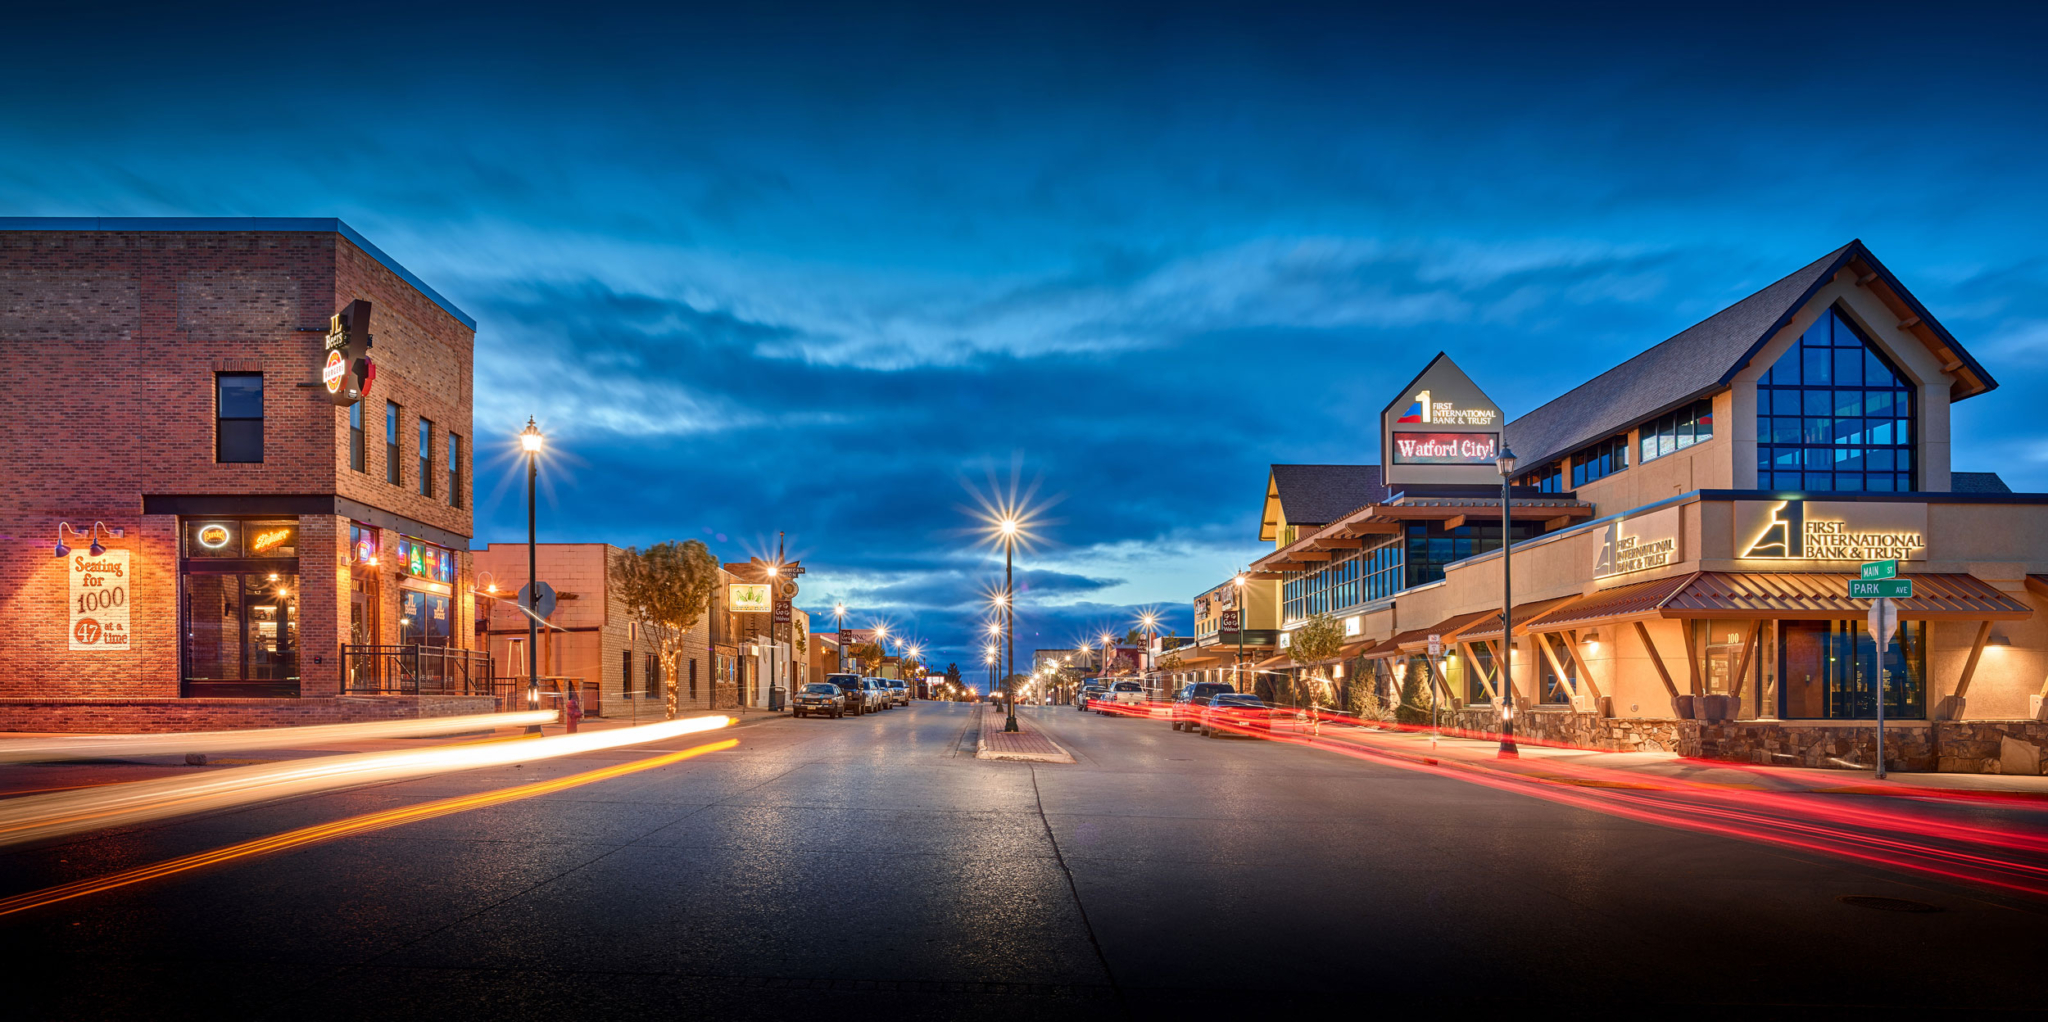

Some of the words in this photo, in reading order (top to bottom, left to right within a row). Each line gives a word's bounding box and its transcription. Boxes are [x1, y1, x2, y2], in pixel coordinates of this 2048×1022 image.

[330, 313, 343, 336] JL
[325, 332, 343, 350] Beers
[1433, 402, 1452, 410] FIRST
[1433, 410, 1496, 418] INTERNATIONAL
[1433, 417, 1456, 425] BANK
[1457, 417, 1465, 425] &
[1467, 417, 1492, 425] TRUST
[1398, 439, 1458, 457] Watford
[1461, 439, 1495, 460] City!
[1805, 521, 1844, 534] FIRST
[1617, 536, 1636, 550] FIRST
[1805, 534, 1925, 547] INTERNATIONAL
[1617, 539, 1674, 560] INTERNATIONAL
[1806, 547, 1848, 559] BANK
[1850, 547, 1862, 559] &
[1866, 547, 1912, 559] TRUST
[75, 556, 123, 577] Seating
[1617, 558, 1635, 573] BANK
[1636, 557, 1643, 569] &
[1643, 552, 1668, 568] TRUST
[1863, 565, 1879, 578] MAIN
[1886, 566, 1893, 574] ST
[83, 573, 105, 587] for
[1854, 583, 1879, 594] PARK
[1895, 586, 1908, 594] AVE
[78, 586, 124, 614] 1000
[78, 623, 98, 643] 47
[104, 622, 114, 631] at
[116, 623, 123, 631] a
[103, 632, 128, 644] time
[1727, 633, 1739, 643] 100
